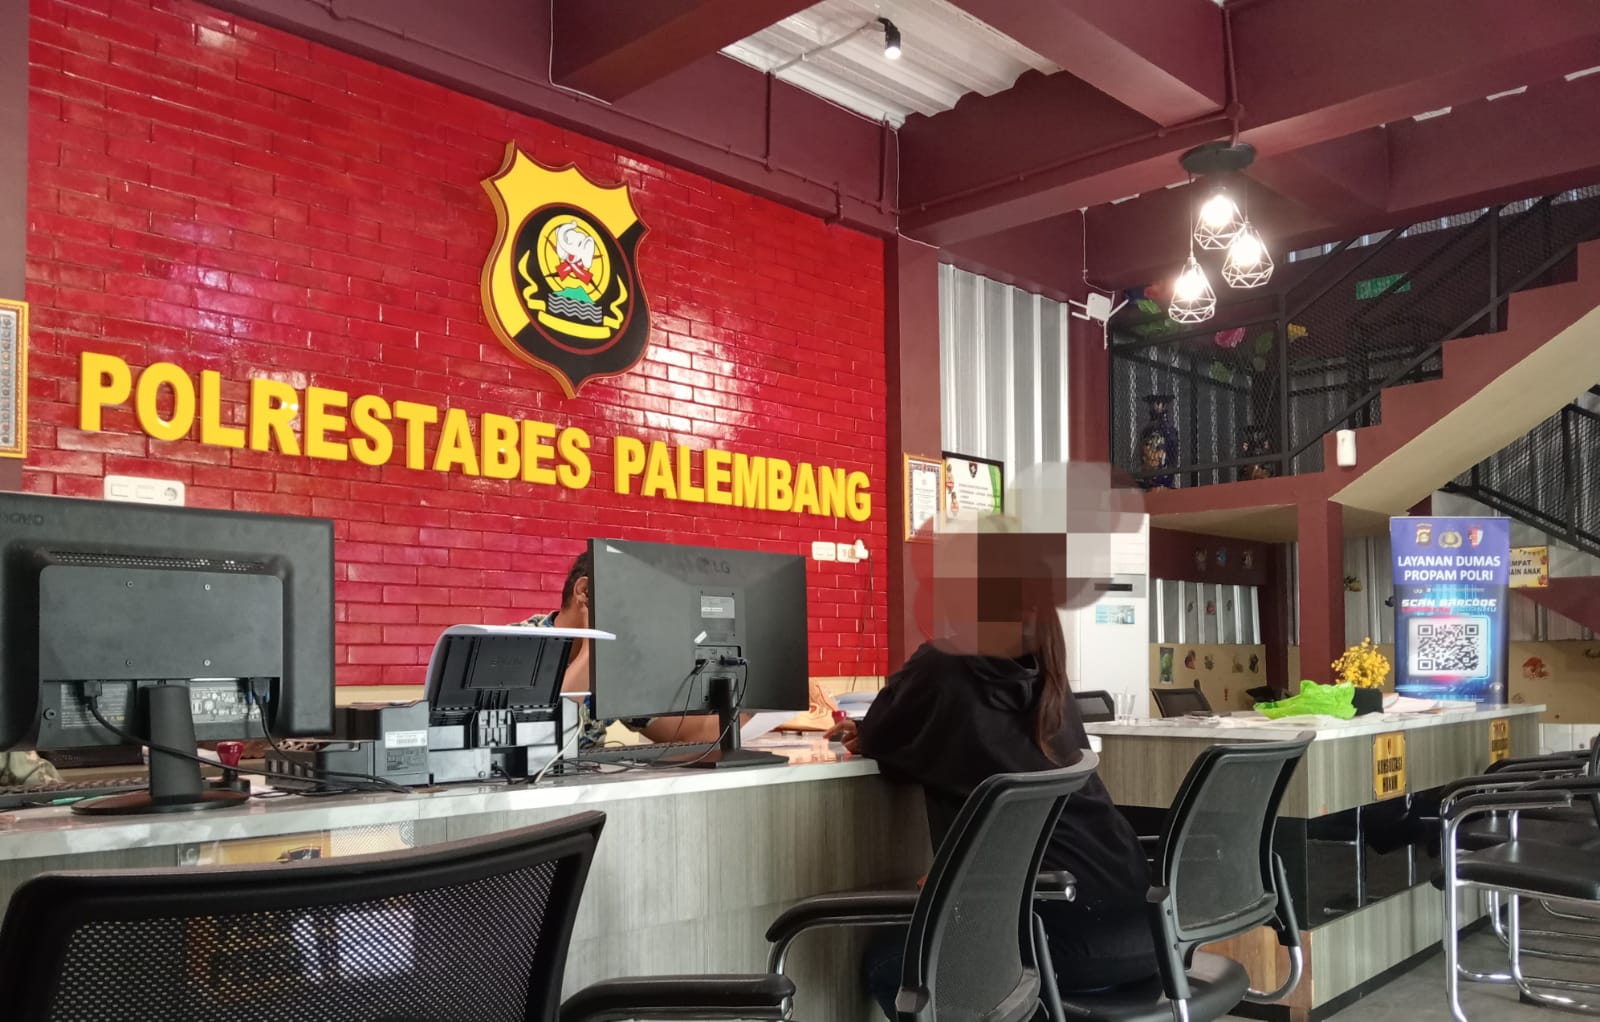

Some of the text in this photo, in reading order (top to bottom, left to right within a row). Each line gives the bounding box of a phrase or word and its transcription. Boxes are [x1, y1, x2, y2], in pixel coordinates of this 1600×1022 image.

[79, 351, 872, 522] POLRESTABES PALEMBANG
[1398, 555, 1501, 567] LAYANAN DUMAS
[1404, 569, 1493, 581] PROPAM POLRI
[1523, 567, 1541, 575] ANAK
[1402, 598, 1497, 608] SCAN BARCODE
